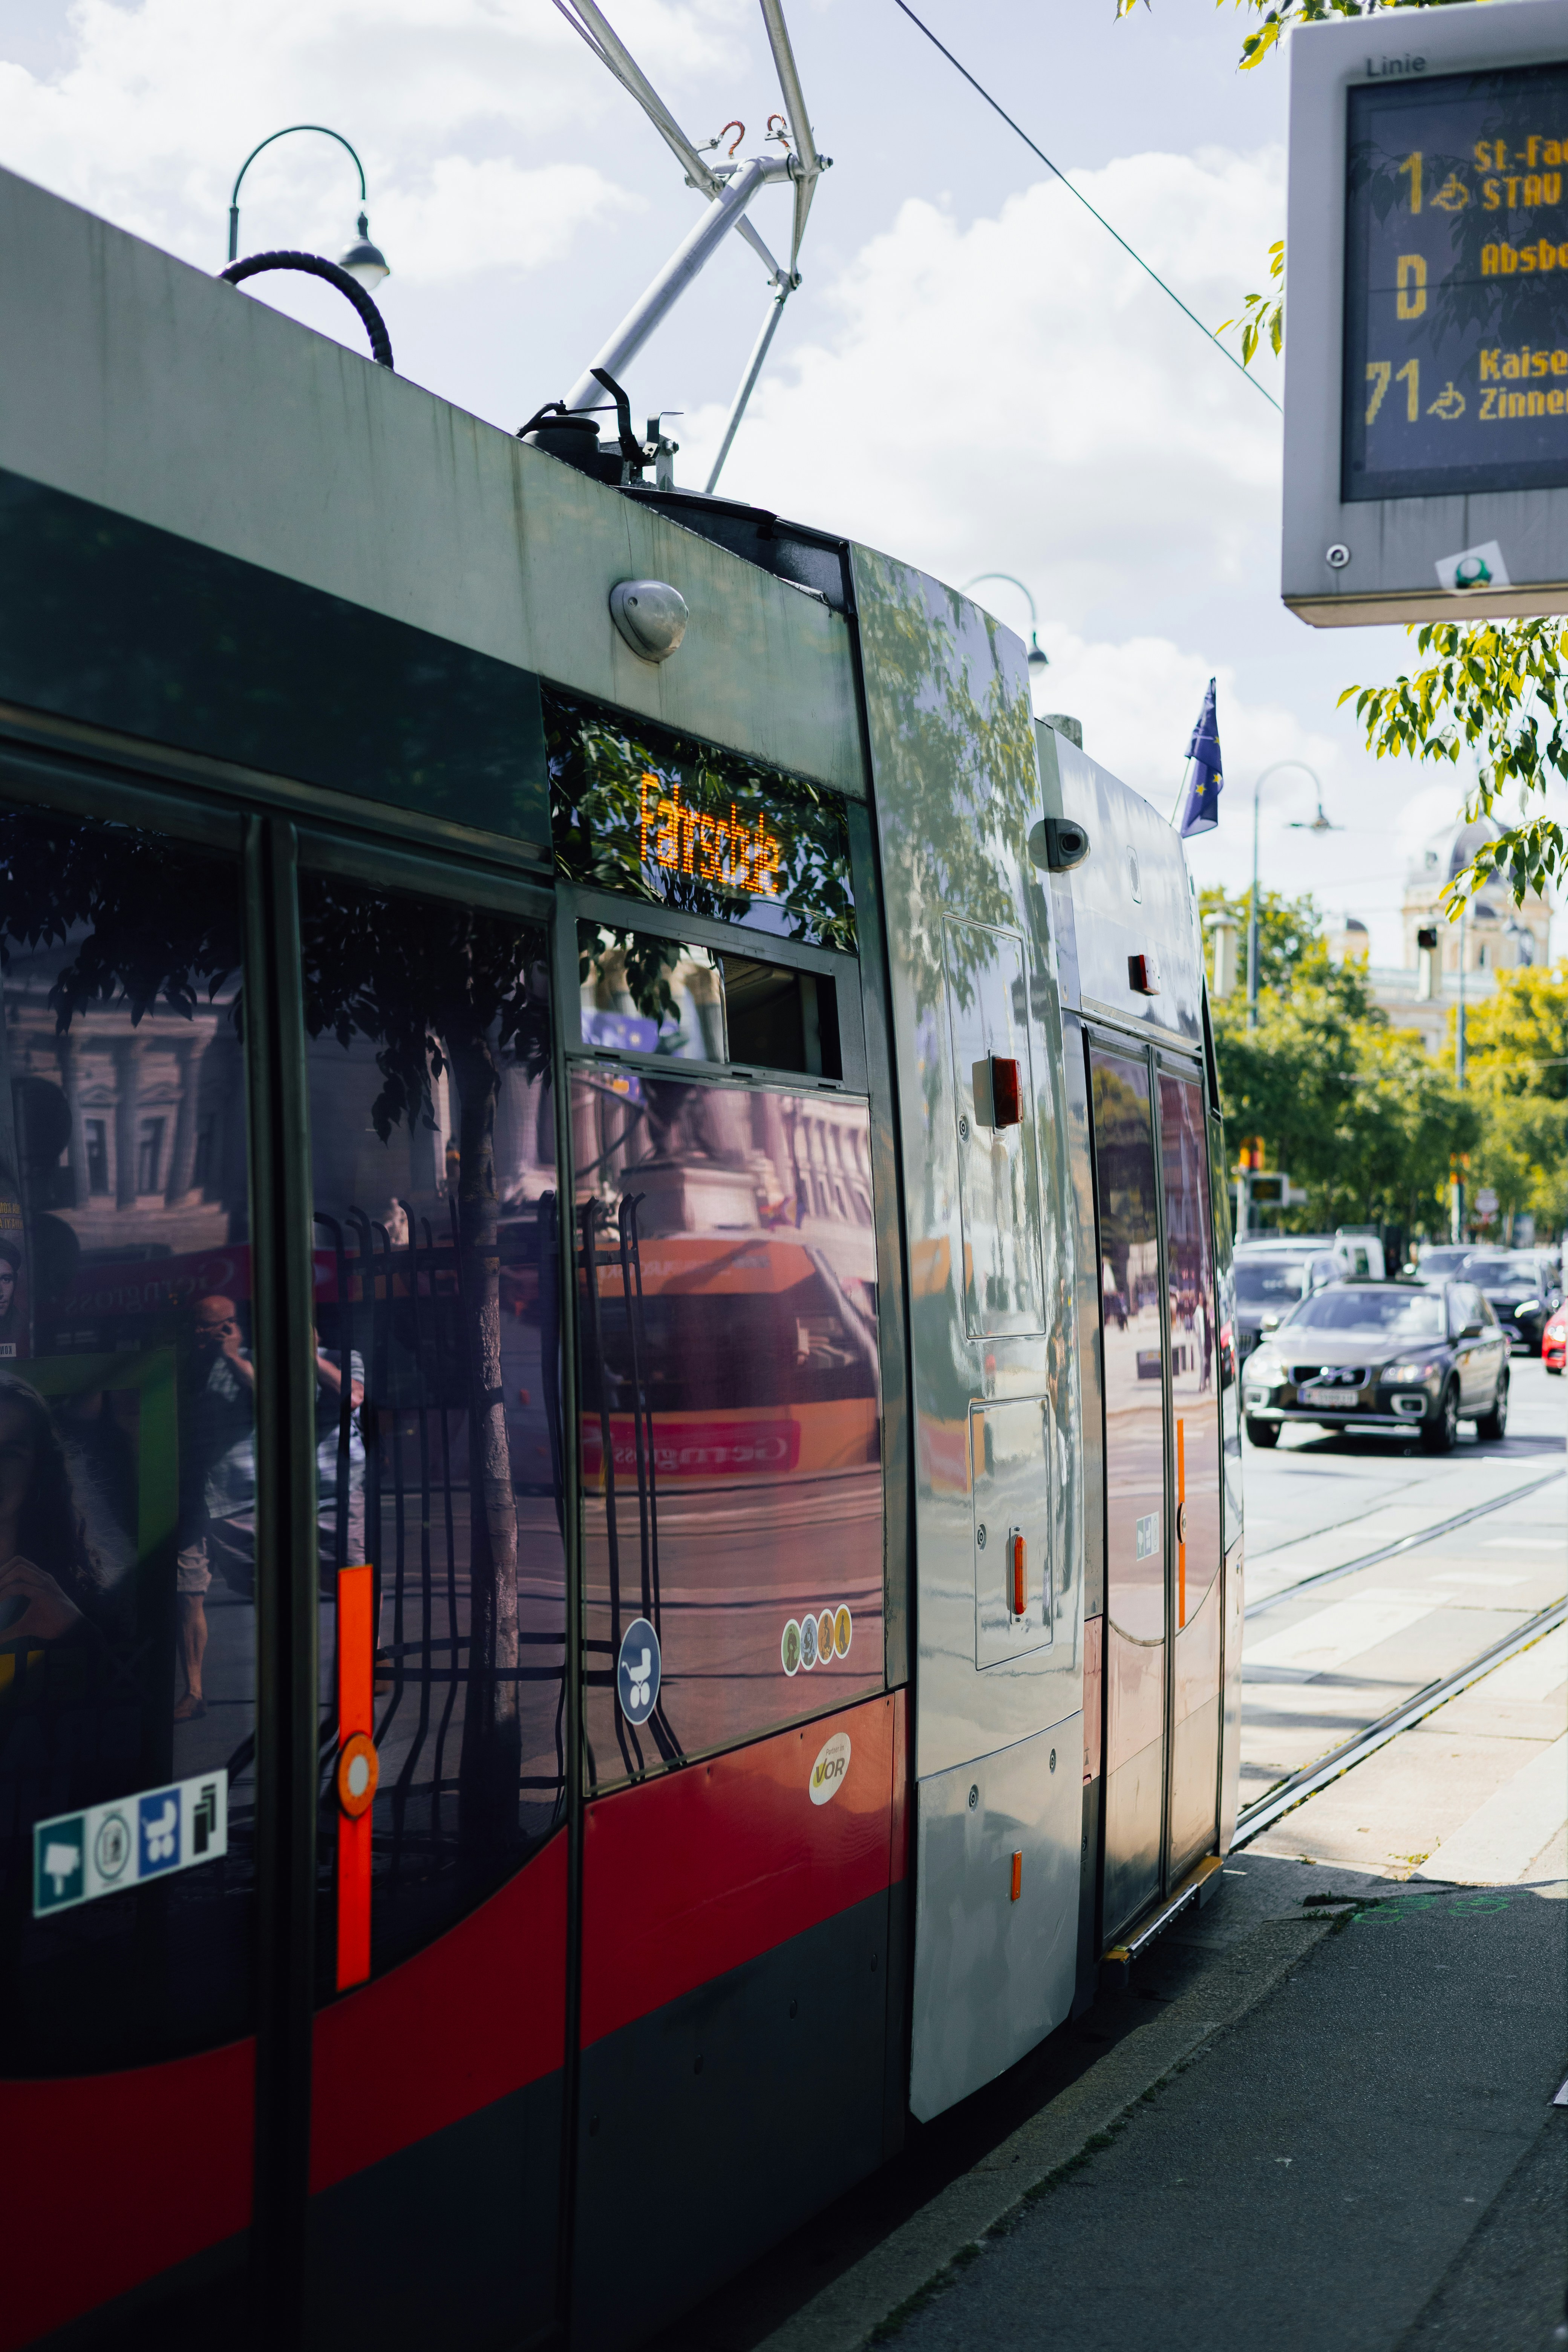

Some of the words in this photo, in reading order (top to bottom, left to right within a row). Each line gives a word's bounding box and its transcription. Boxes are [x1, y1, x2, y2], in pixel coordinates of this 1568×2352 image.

[1366, 54, 1426, 77] Linie
[1399, 152, 1422, 214] 1
[1483, 172, 1562, 210] STAU
[1397, 254, 1427, 320] D
[1480, 345, 1568, 381] Kaise
[1365, 359, 1419, 425] 71
[1479, 387, 1568, 420] Zinne
[642, 773, 779, 898] Fahrschule
[826, 1747, 839, 1756] Partner
[816, 1758, 845, 1784] VOR
